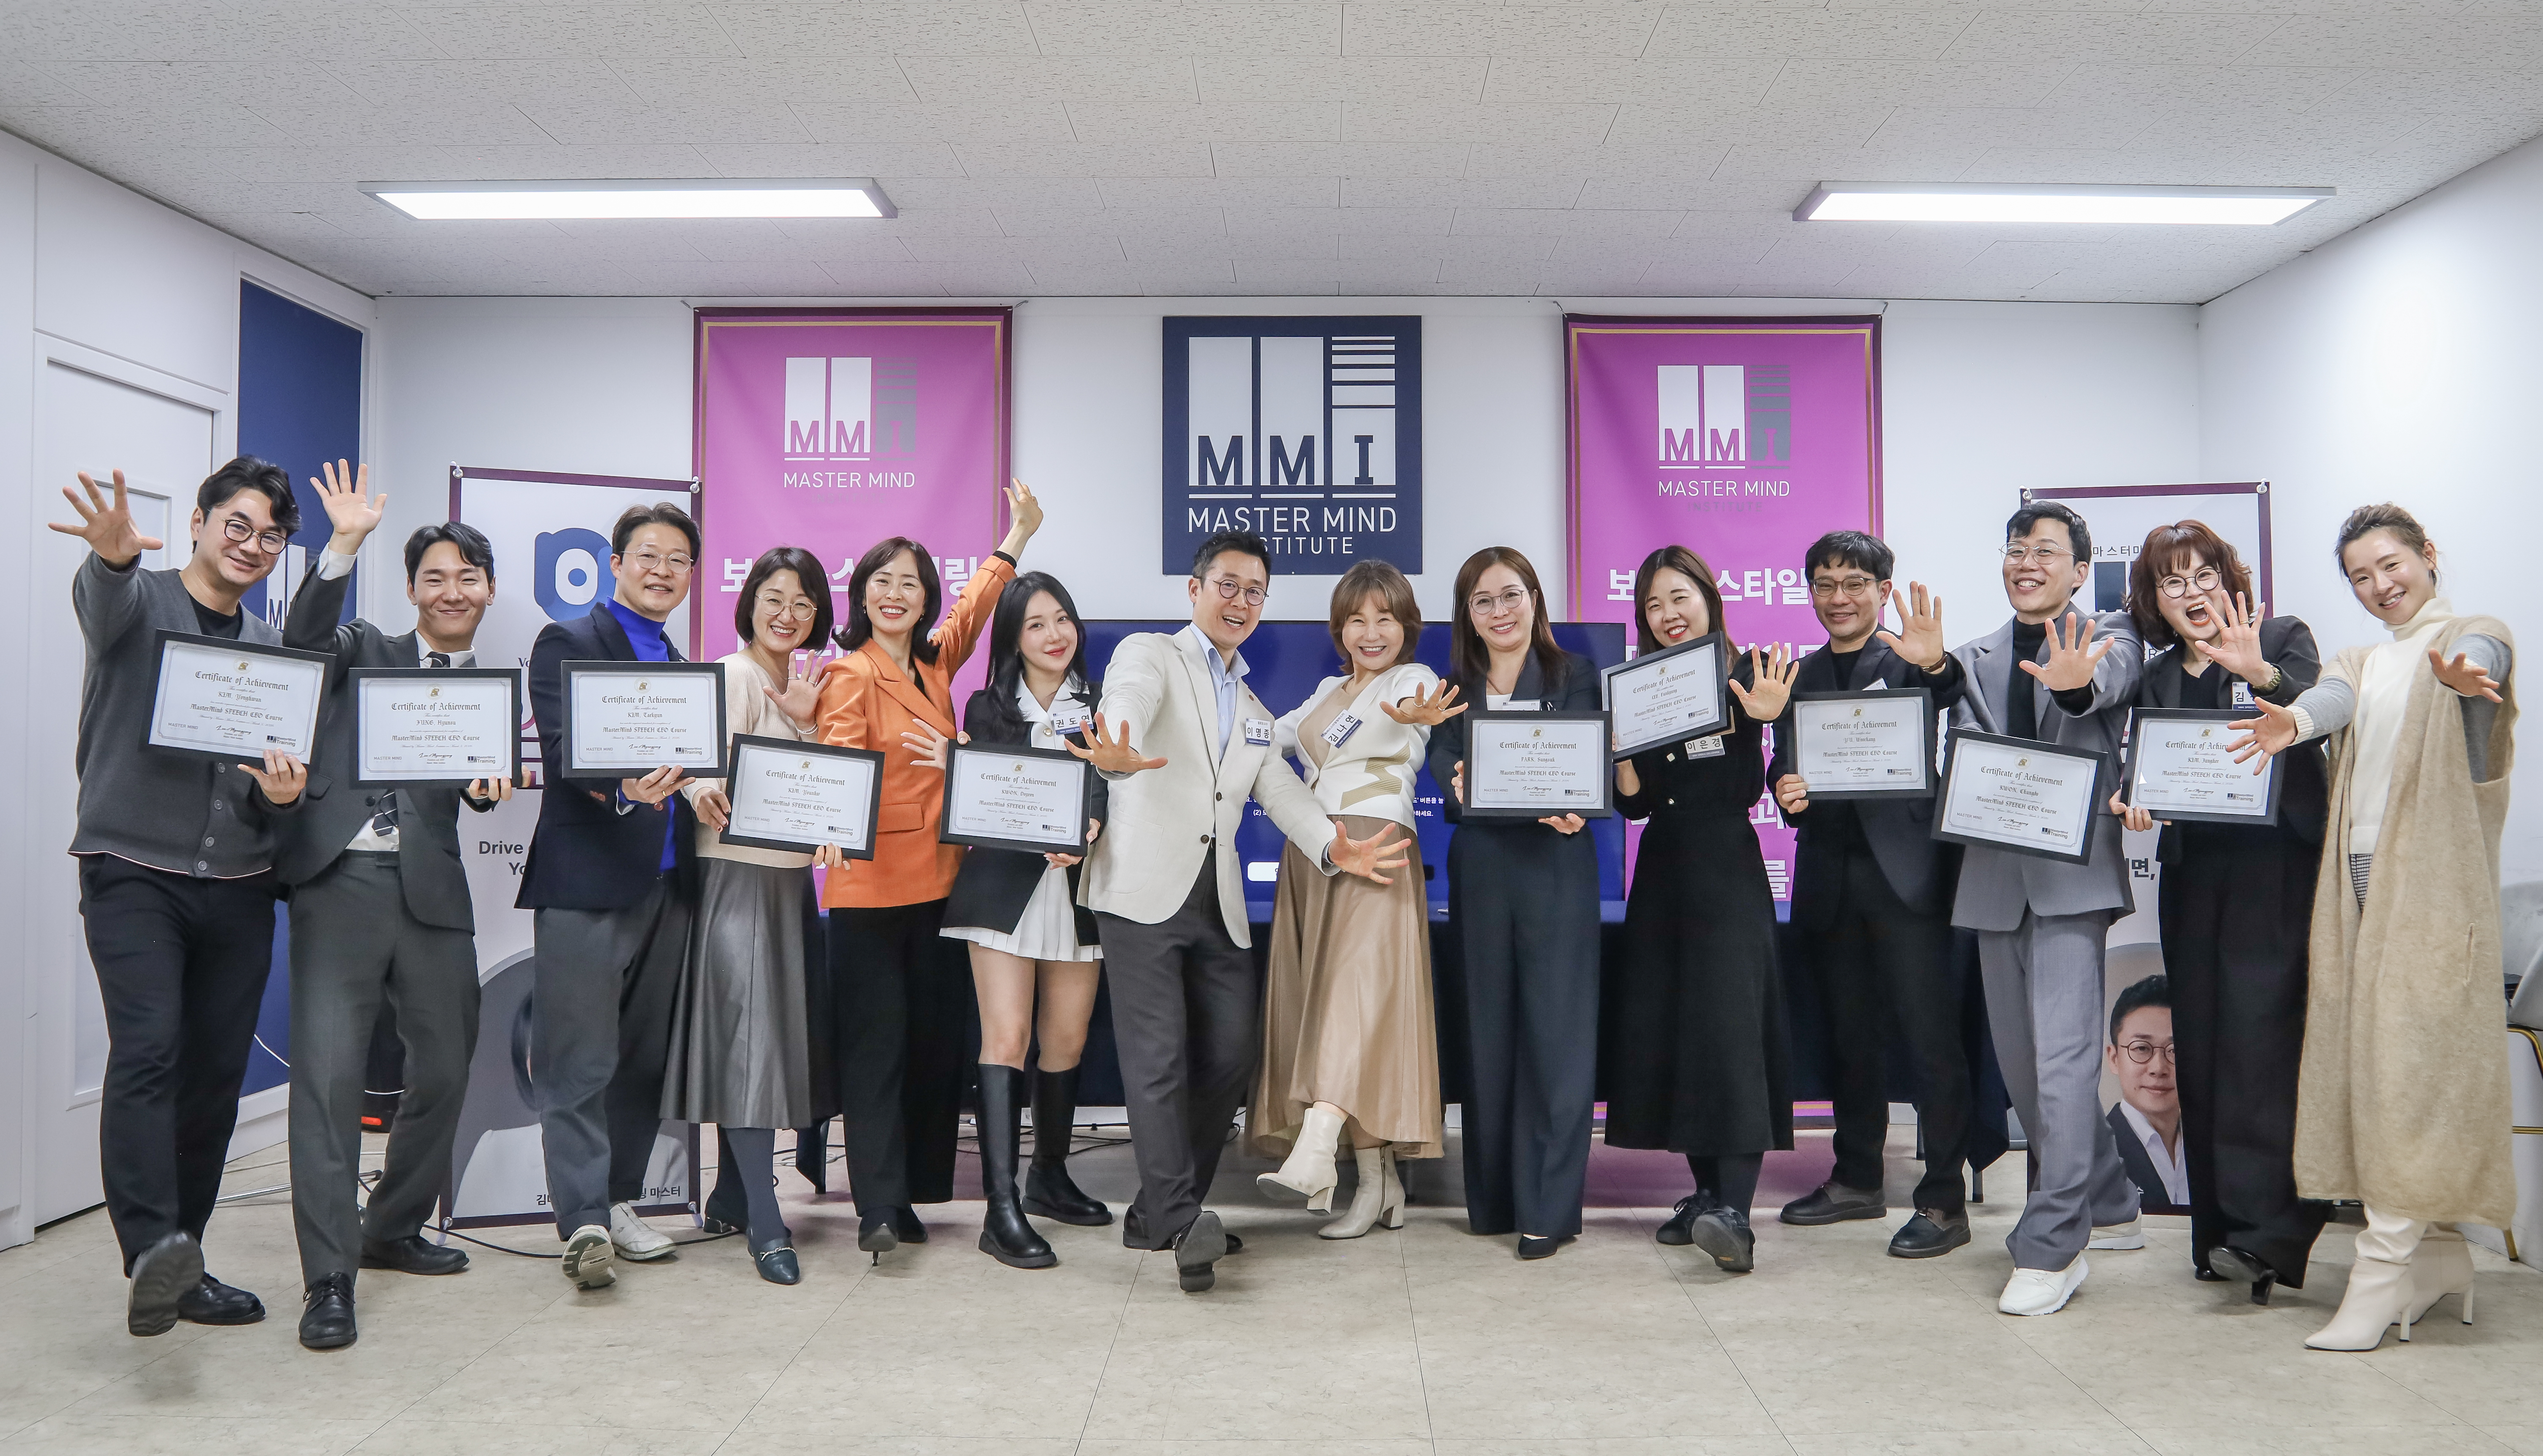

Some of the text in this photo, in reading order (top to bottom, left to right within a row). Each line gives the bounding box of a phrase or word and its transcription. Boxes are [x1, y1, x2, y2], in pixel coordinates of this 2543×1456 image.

[1665, 428, 1777, 461] MMI
[1198, 435, 1374, 486] MMI
[784, 472, 915, 488] MASTER MIND
[1658, 480, 1790, 496] MASTER MIND
[1687, 501, 1762, 512] INSTITUTE
[1188, 507, 1396, 533] MASTER MIND
[1259, 537, 1353, 554] STITUTE
[195, 671, 288, 691] Certificate of Achievement
[1633, 681, 1657, 694] Certificate
[1666, 669, 1696, 684] Achievement
[218, 691, 233, 699] KIM,
[602, 696, 635, 705] Certificate
[638, 696, 645, 705] of
[190, 704, 223, 714] MasterMind
[224, 708, 248, 717] SPEECH
[265, 713, 283, 721] Course
[391, 702, 427, 712] Certificate
[430, 702, 436, 712] of
[1634, 707, 1655, 718] MasterMind
[1656, 702, 1672, 711] SPEECH
[1822, 722, 1851, 731] Certificate
[1853, 721, 1859, 729] of
[1500, 742, 1530, 750] Certificate
[1532, 742, 1539, 750] of
[2165, 741, 2197, 750] Certificate
[2199, 742, 2206, 750] of
[766, 770, 845, 785] Certificate of Achievement
[981, 773, 1011, 782] Certificate
[1021, 777, 1056, 787] Achievement
[1980, 766, 2063, 786] Certificate of Achievement
[763, 799, 790, 807] MasterMind
[1975, 796, 2004, 805] MasterMind
[2005, 801, 2026, 809] SPEECH
[2041, 806, 2057, 814] Course
[479, 840, 523, 854] Drive
[651, 1186, 680, 1199] 마스터
